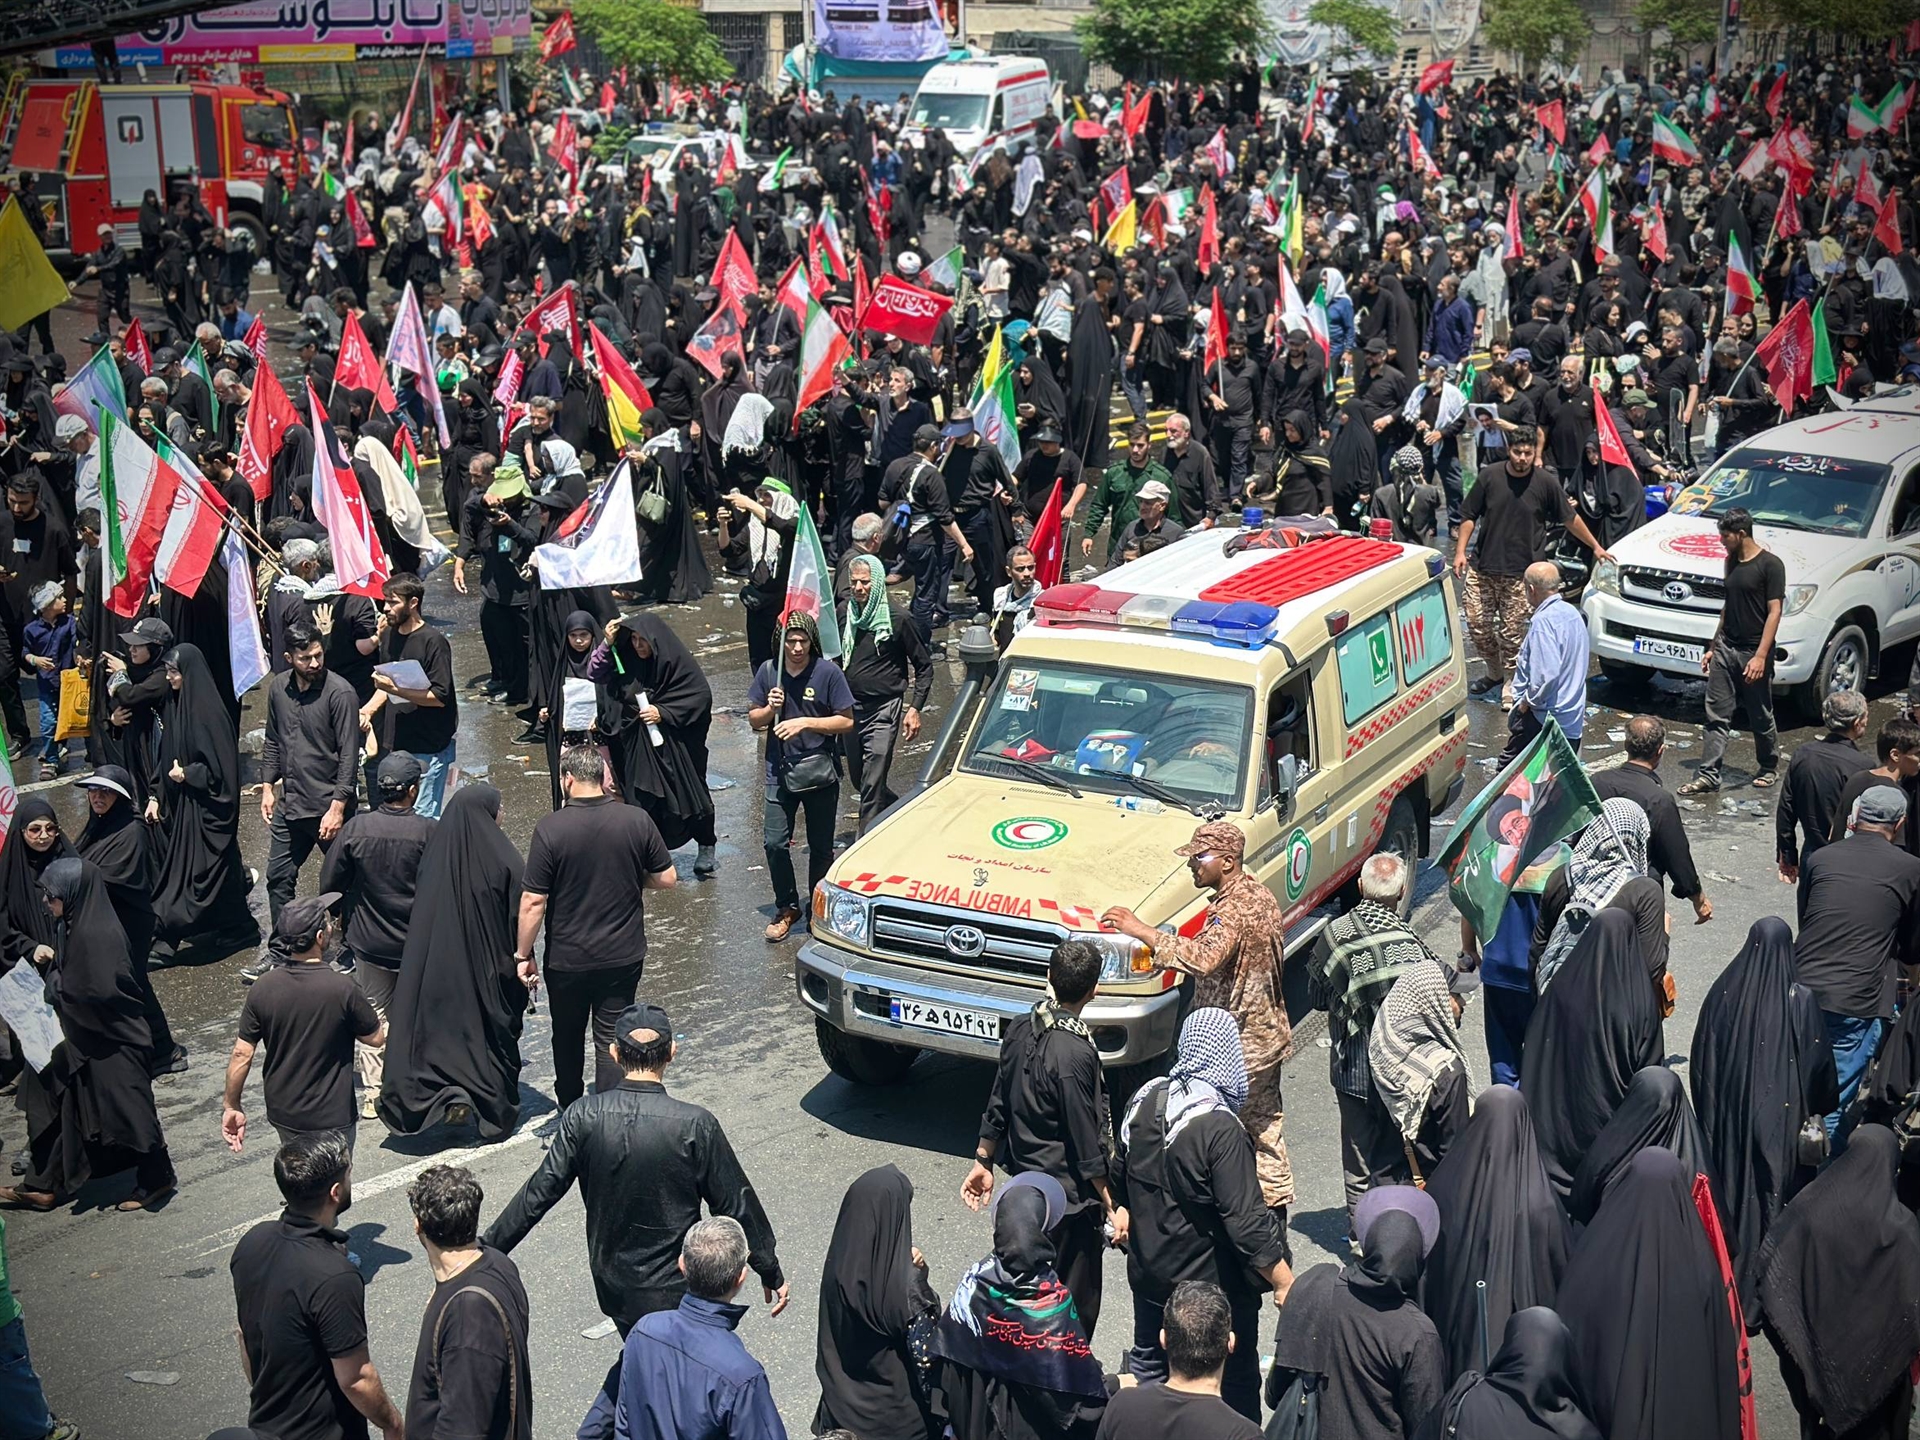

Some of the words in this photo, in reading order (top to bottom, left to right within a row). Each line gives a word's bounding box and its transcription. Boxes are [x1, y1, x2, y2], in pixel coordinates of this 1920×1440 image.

[947, 853, 975, 862] نجات
[984, 858, 1013, 868] امداد
[1013, 861, 1052, 875] سازمان
